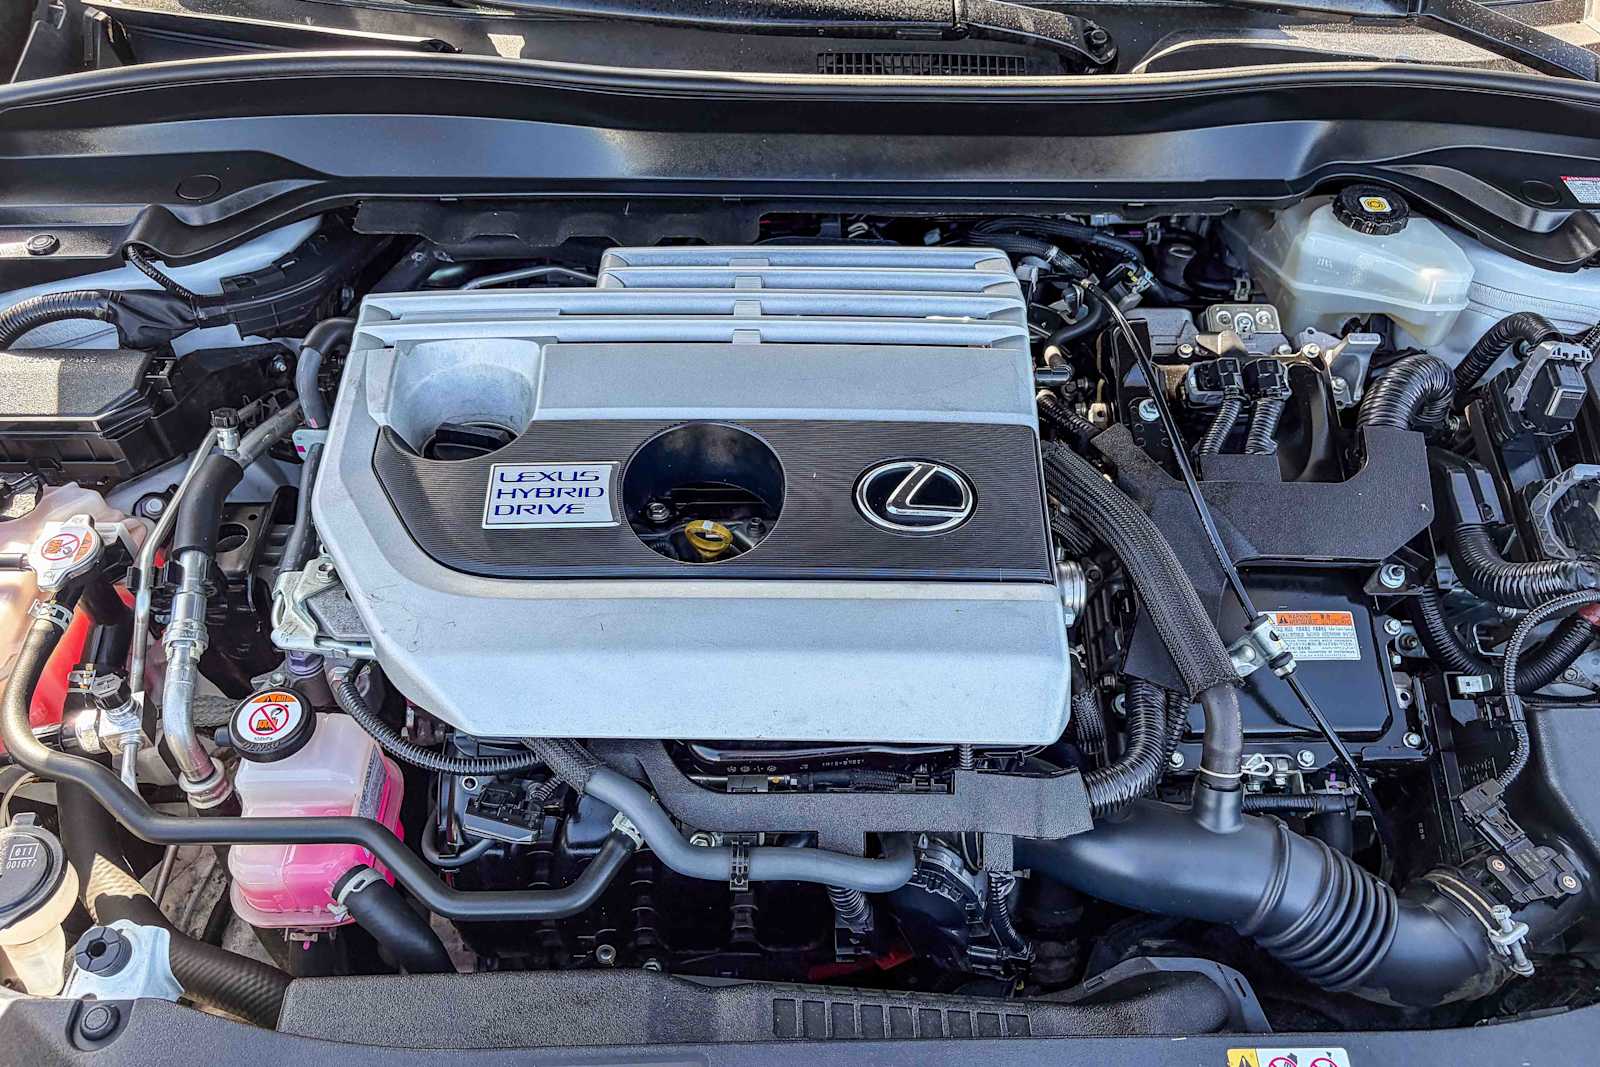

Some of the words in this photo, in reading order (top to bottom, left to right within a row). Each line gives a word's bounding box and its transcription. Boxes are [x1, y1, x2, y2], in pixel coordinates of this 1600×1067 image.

[500, 471, 600, 482] LEXUS
[496, 487, 605, 499] HYBRID
[494, 503, 586, 516] DRIVE
